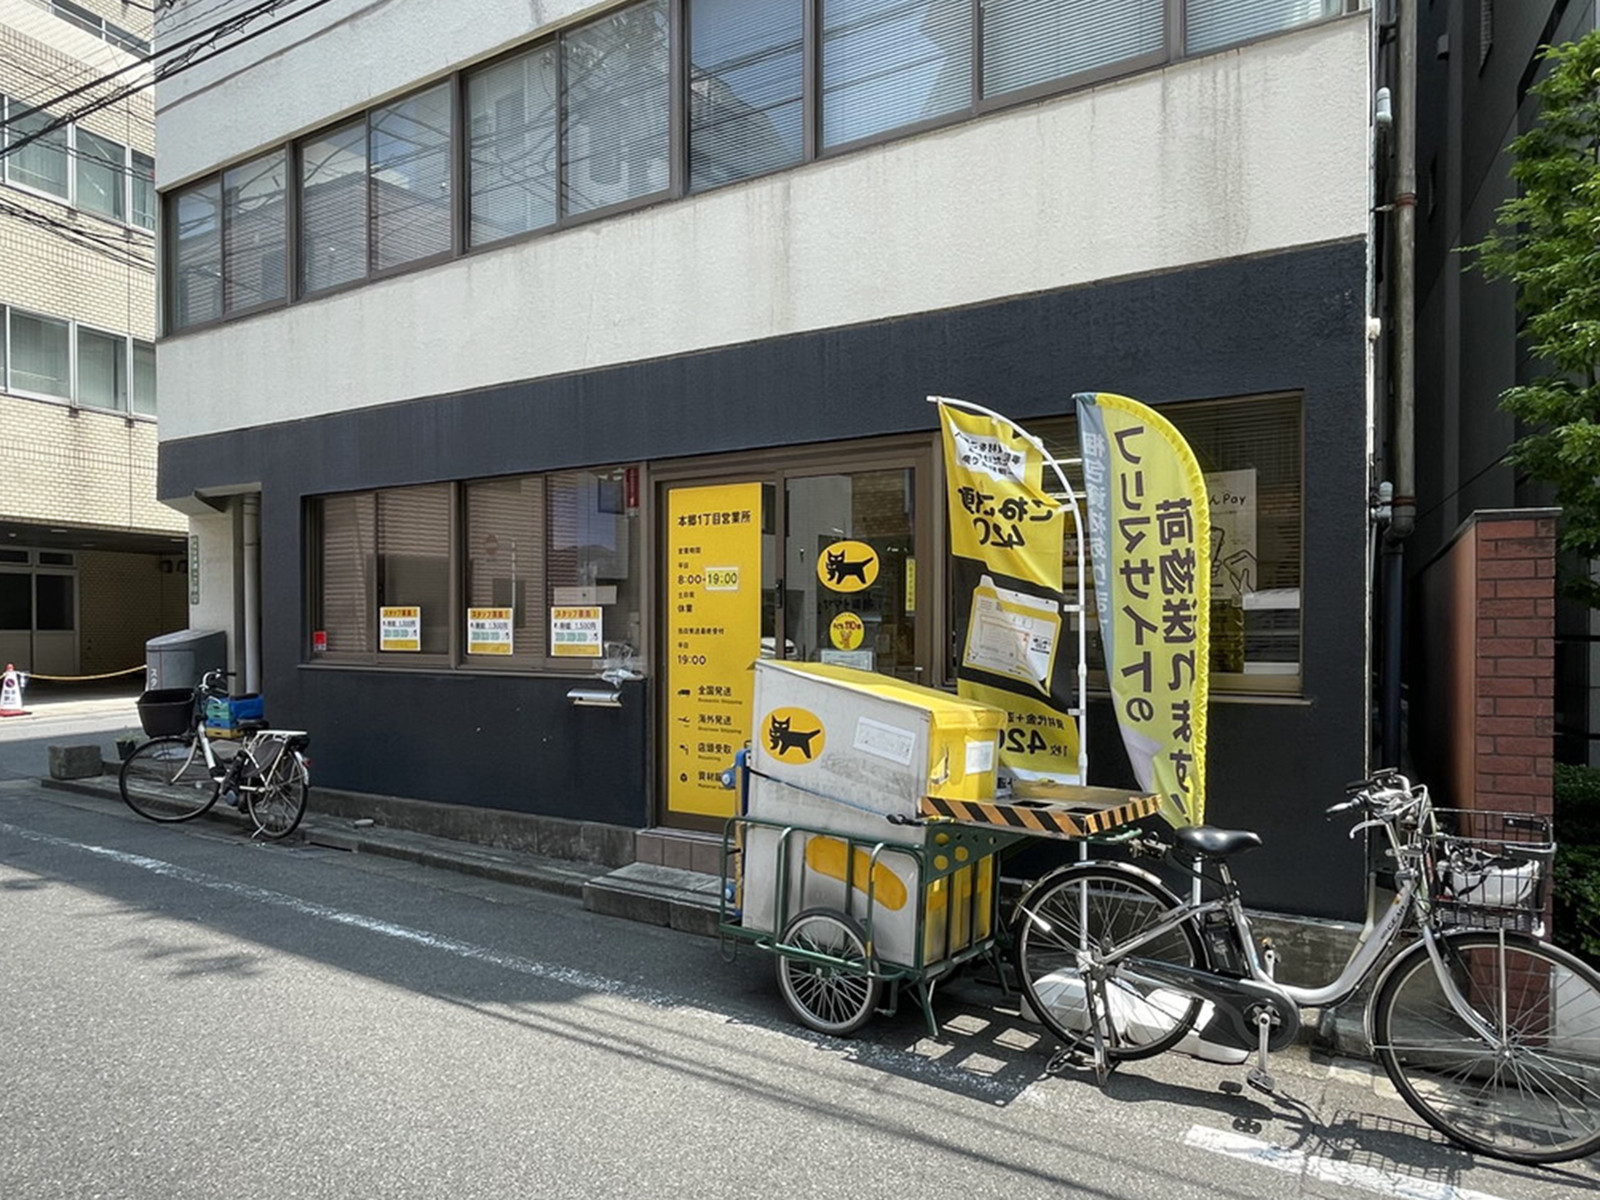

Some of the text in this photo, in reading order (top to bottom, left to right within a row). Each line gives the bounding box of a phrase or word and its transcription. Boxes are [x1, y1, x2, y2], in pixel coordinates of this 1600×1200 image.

[678, 510, 751, 526] 本郷1丁目営業所
[678, 655, 706, 665] 19:00
[698, 685, 732, 697] 全国発送
[698, 713, 732, 726] 海外発送
[698, 742, 732, 754] 店頭受取
